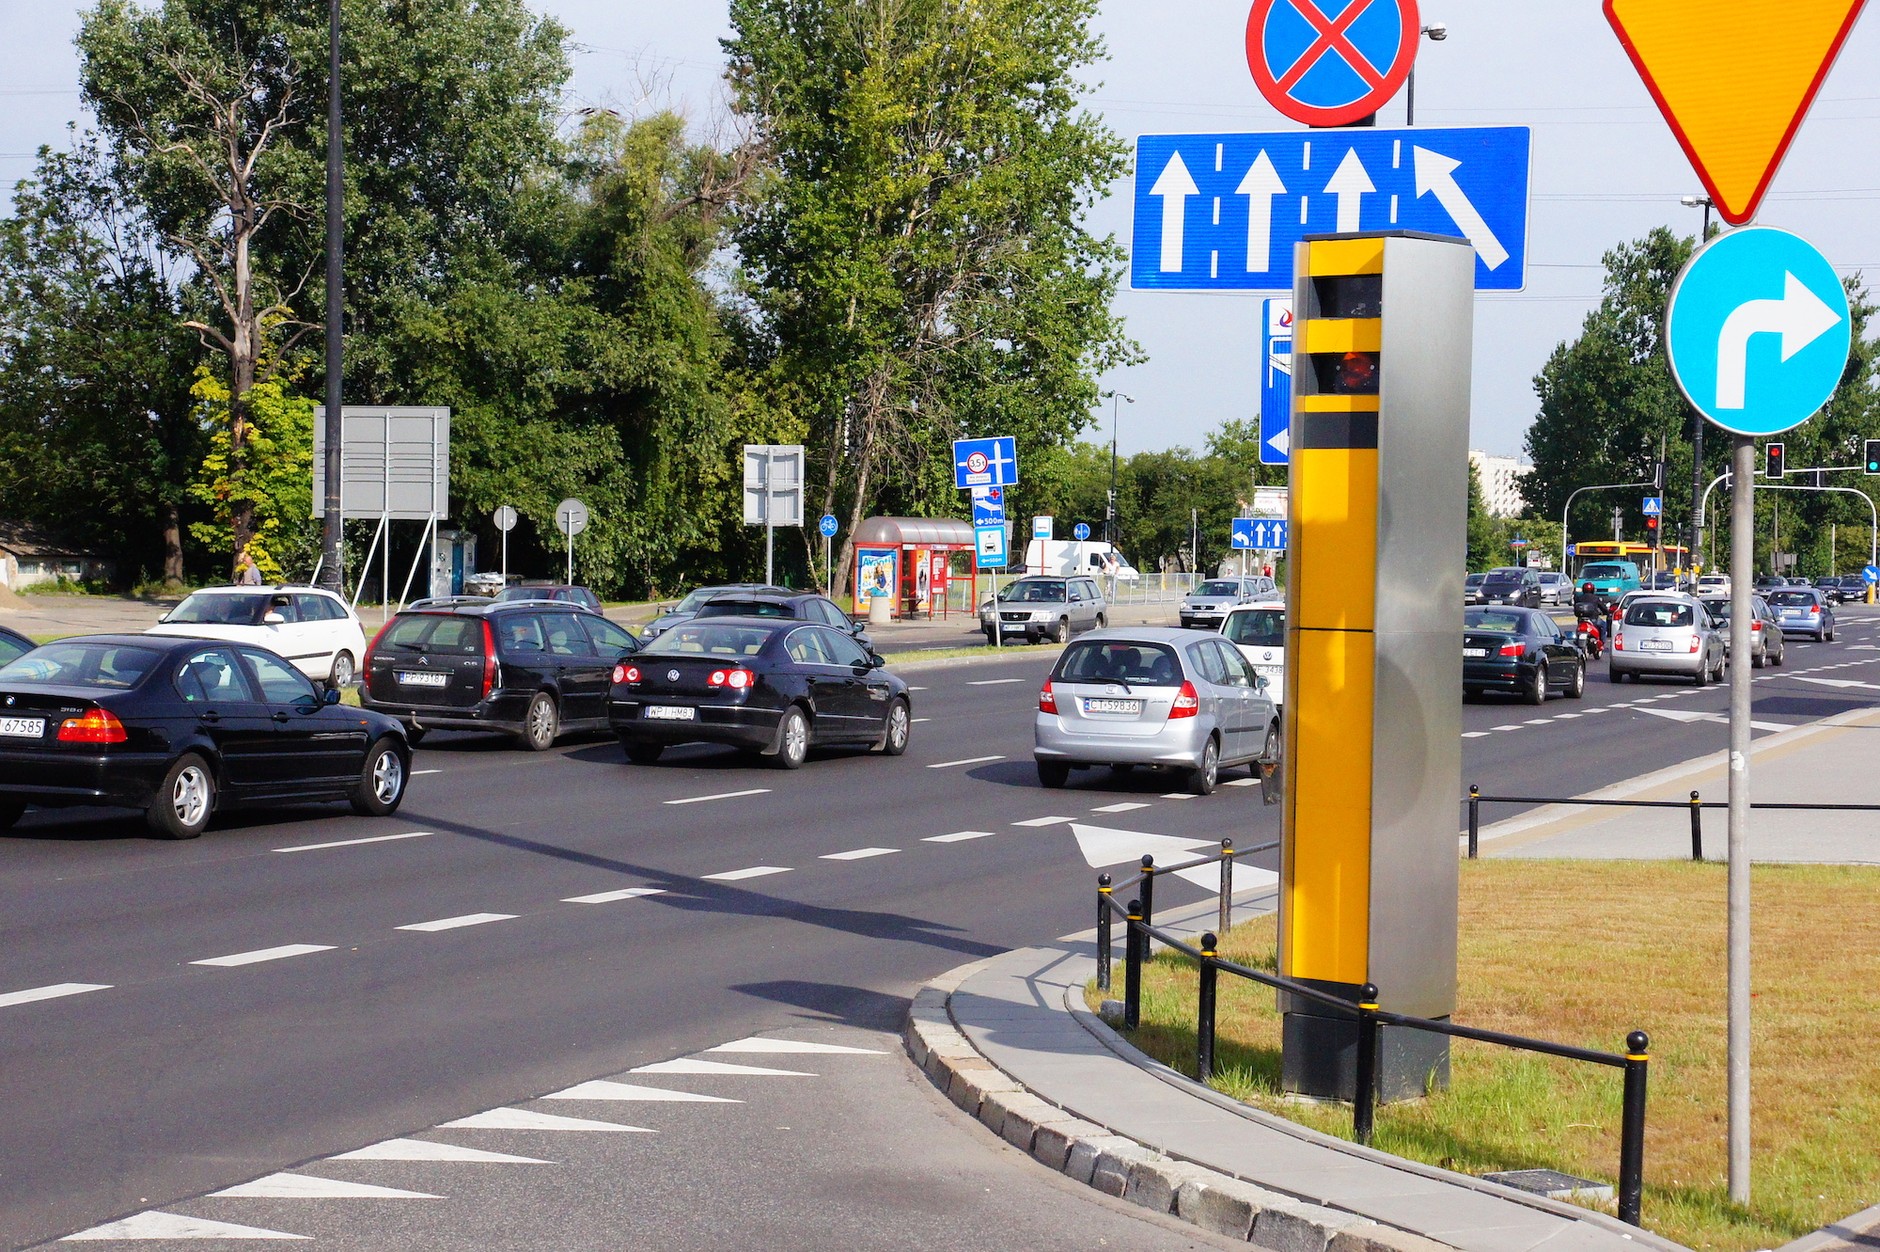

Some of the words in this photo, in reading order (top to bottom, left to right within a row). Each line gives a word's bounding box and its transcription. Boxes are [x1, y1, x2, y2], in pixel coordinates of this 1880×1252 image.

[984, 517, 1003, 525] 500m
[405, 672, 415, 681] PP
[419, 672, 444, 683] 93187
[1090, 700, 1104, 710] CT
[1107, 700, 1137, 710] 59836
[671, 708, 694, 718] HM83
[4, 719, 42, 734] 67585
